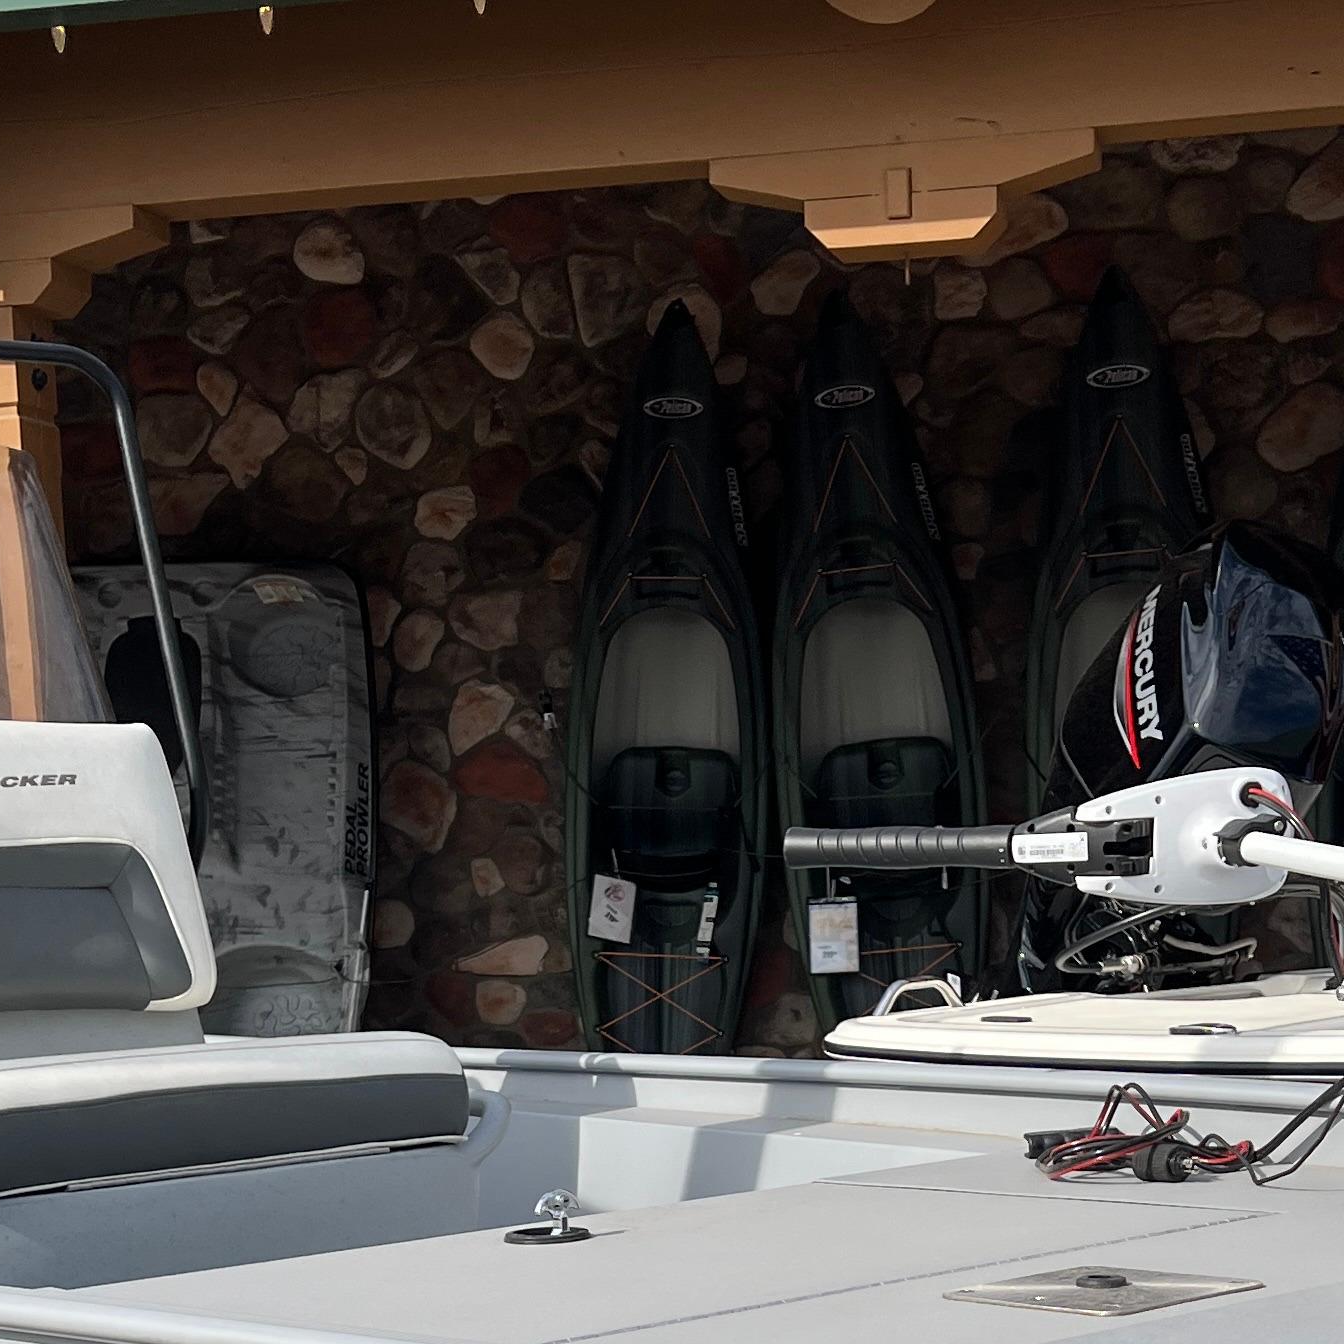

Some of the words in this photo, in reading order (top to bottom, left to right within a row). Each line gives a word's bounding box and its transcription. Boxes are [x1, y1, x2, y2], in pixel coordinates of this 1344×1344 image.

[1134, 585, 1164, 742] MERCURY
[345, 801, 357, 875] PEDAL
[357, 763, 369, 876] PROWLER
